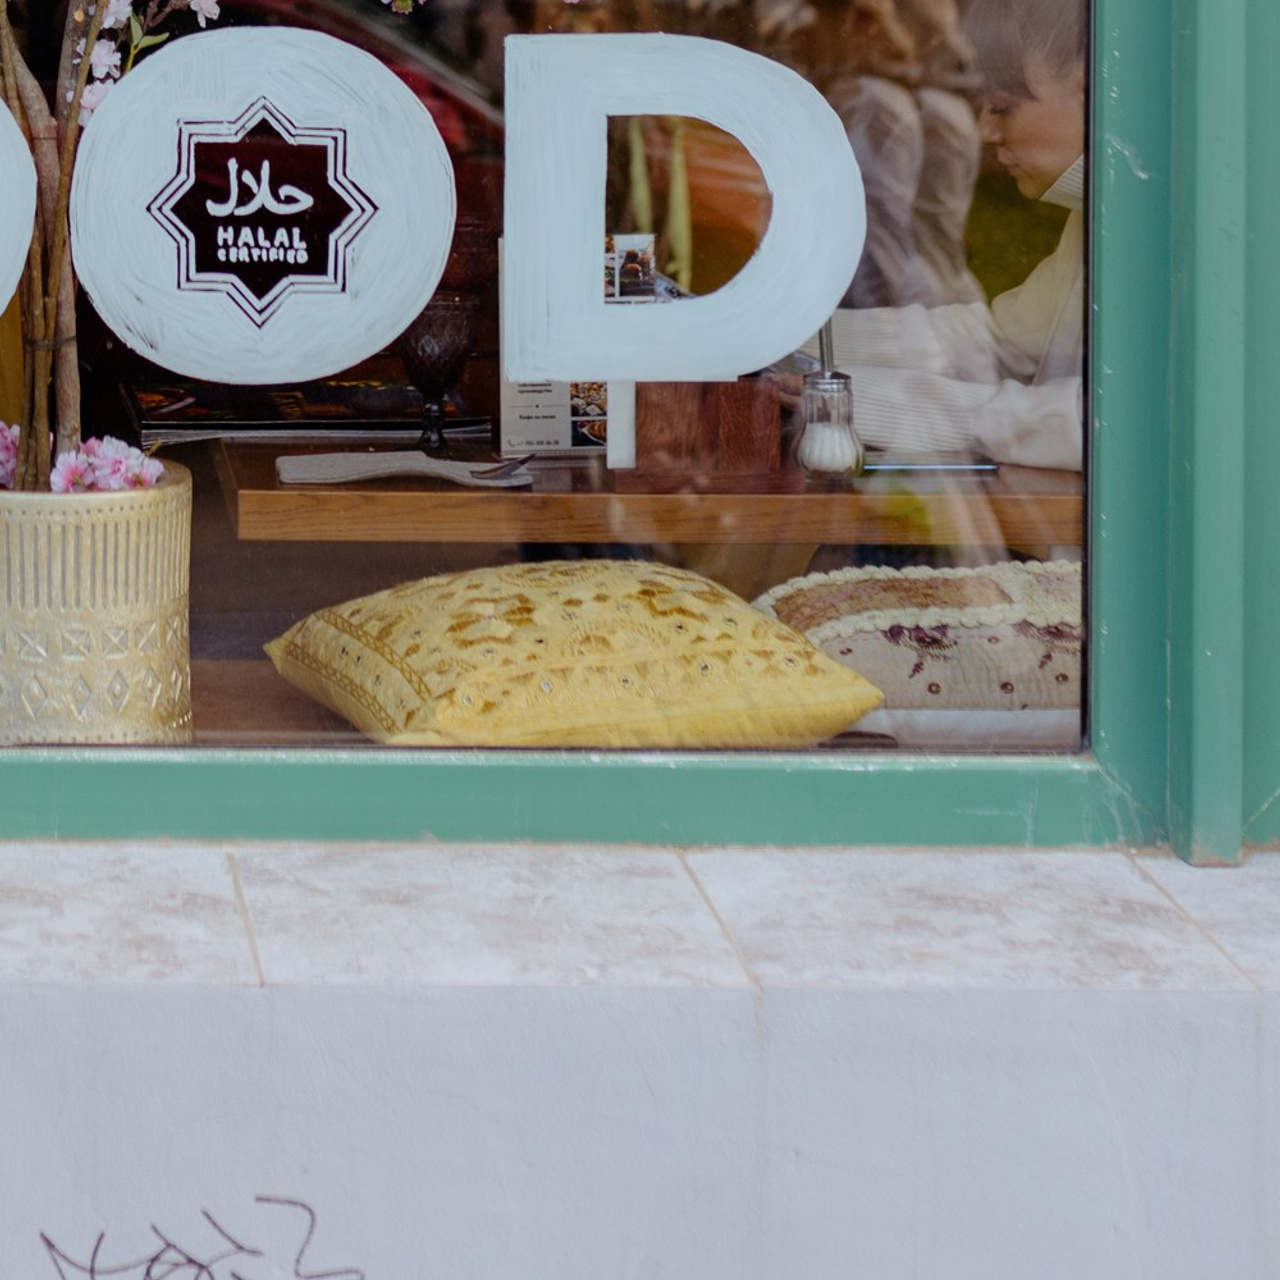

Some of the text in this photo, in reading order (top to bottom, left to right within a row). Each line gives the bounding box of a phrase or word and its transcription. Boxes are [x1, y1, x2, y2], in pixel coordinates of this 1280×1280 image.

[206, 157, 314, 217] حلال
[217, 226, 307, 249] HALAL
[217, 246, 309, 264] CERTIFIED
